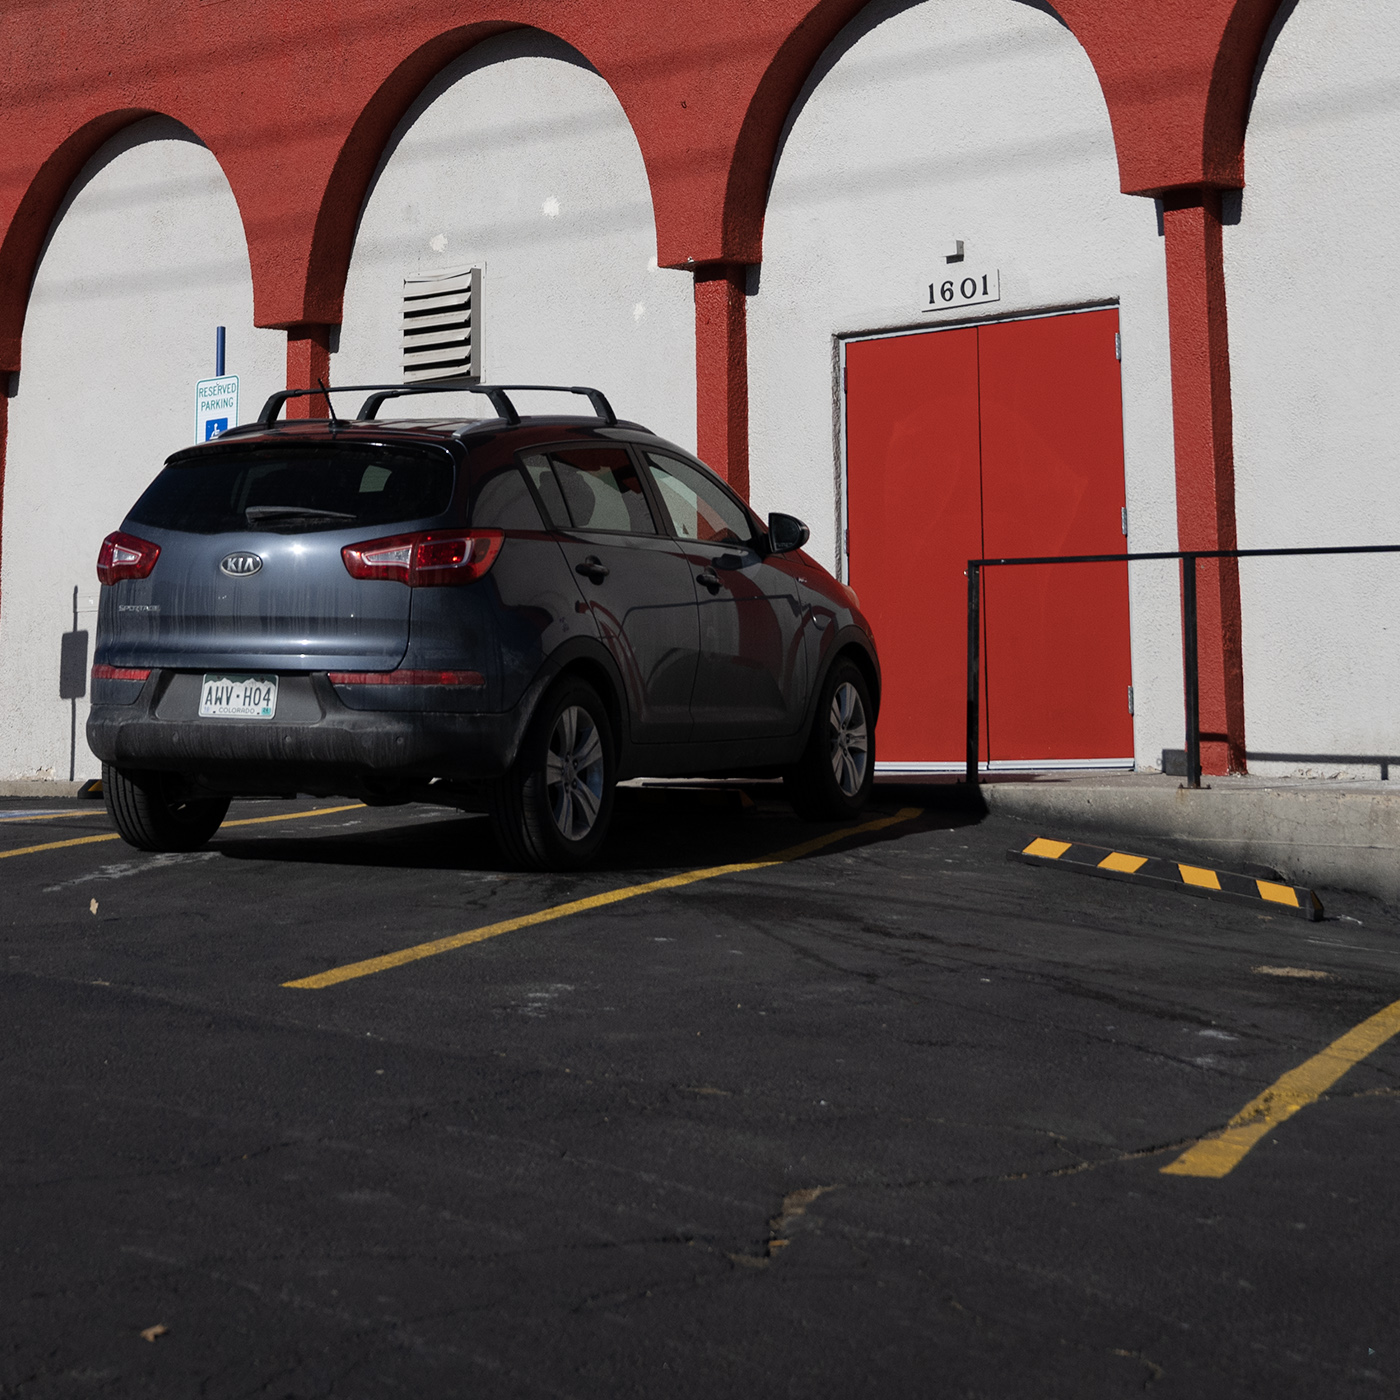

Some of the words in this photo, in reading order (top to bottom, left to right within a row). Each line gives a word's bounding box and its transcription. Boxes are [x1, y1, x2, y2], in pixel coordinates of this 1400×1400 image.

[928, 274, 989, 304] 1601
[199, 383, 237, 398] RESERVED
[201, 397, 234, 411] PARKING
[226, 557, 255, 571] KIA
